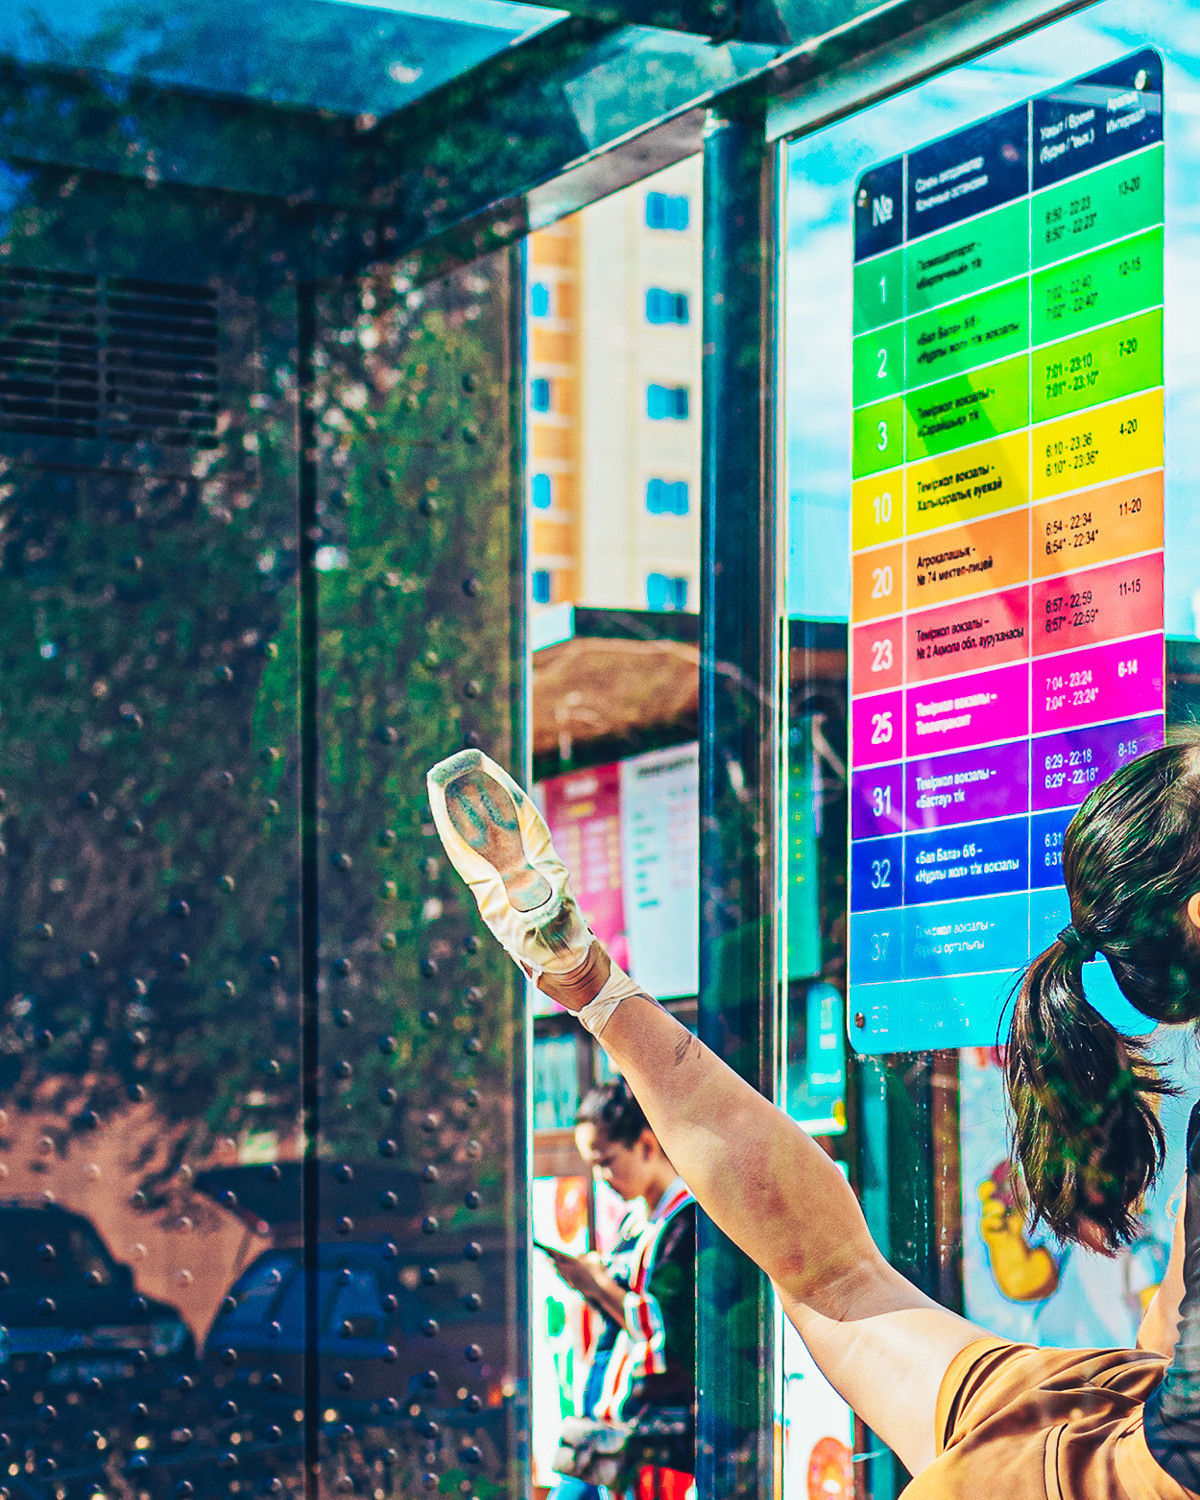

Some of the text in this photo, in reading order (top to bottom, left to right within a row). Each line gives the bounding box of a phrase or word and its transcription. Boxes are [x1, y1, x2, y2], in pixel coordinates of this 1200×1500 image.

[872, 195, 893, 227] №
[879, 276, 886, 304] 1
[877, 348, 887, 378] 2
[877, 420, 888, 451] 3
[1119, 418, 1138, 435] 4-20
[872, 492, 892, 525] 10
[1119, 497, 1142, 517] 11-20
[1046, 511, 1093, 537] 6:54 22:34
[938, 555, 994, 581] мектеп-лицей
[872, 565, 893, 599] 20
[1119, 578, 1141, 596] 11-15
[1045, 590, 1093, 614] 6:57 22:59
[951, 618, 984, 634] вокзалы
[979, 627, 1025, 649] ауруханасы
[871, 638, 894, 673] 23
[1118, 659, 1139, 678] 6-14
[1046, 669, 1093, 692] 7:04 23:24
[871, 711, 893, 745] 25
[1045, 748, 1093, 771] 6:29 22:18
[1118, 740, 1138, 758] 8-15
[872, 785, 892, 817] 31
[871, 858, 891, 889] 32
